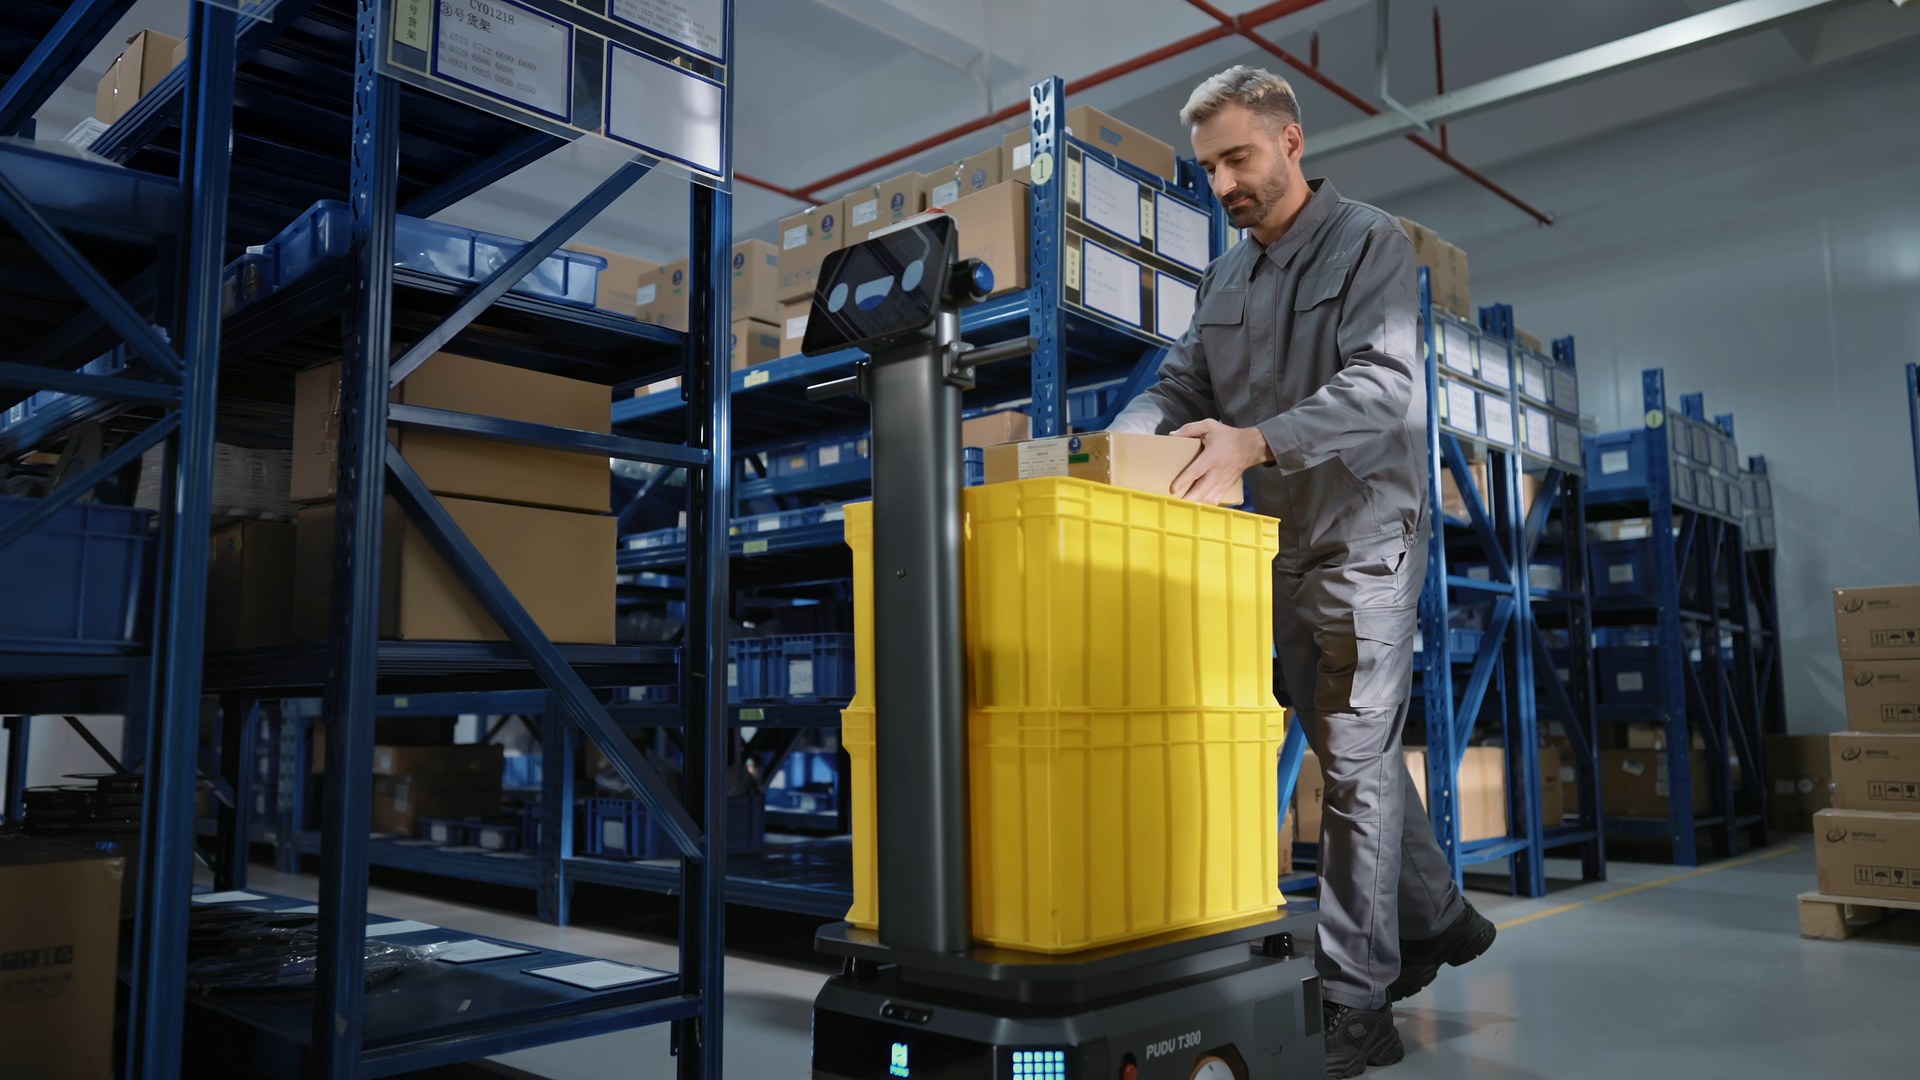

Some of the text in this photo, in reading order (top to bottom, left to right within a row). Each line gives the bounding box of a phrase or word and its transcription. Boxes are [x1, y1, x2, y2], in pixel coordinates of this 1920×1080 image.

[1038, 159, 1045, 180] 1
[1072, 438, 1079, 448] 3
[1146, 1030, 1201, 1060] PUDU T300
